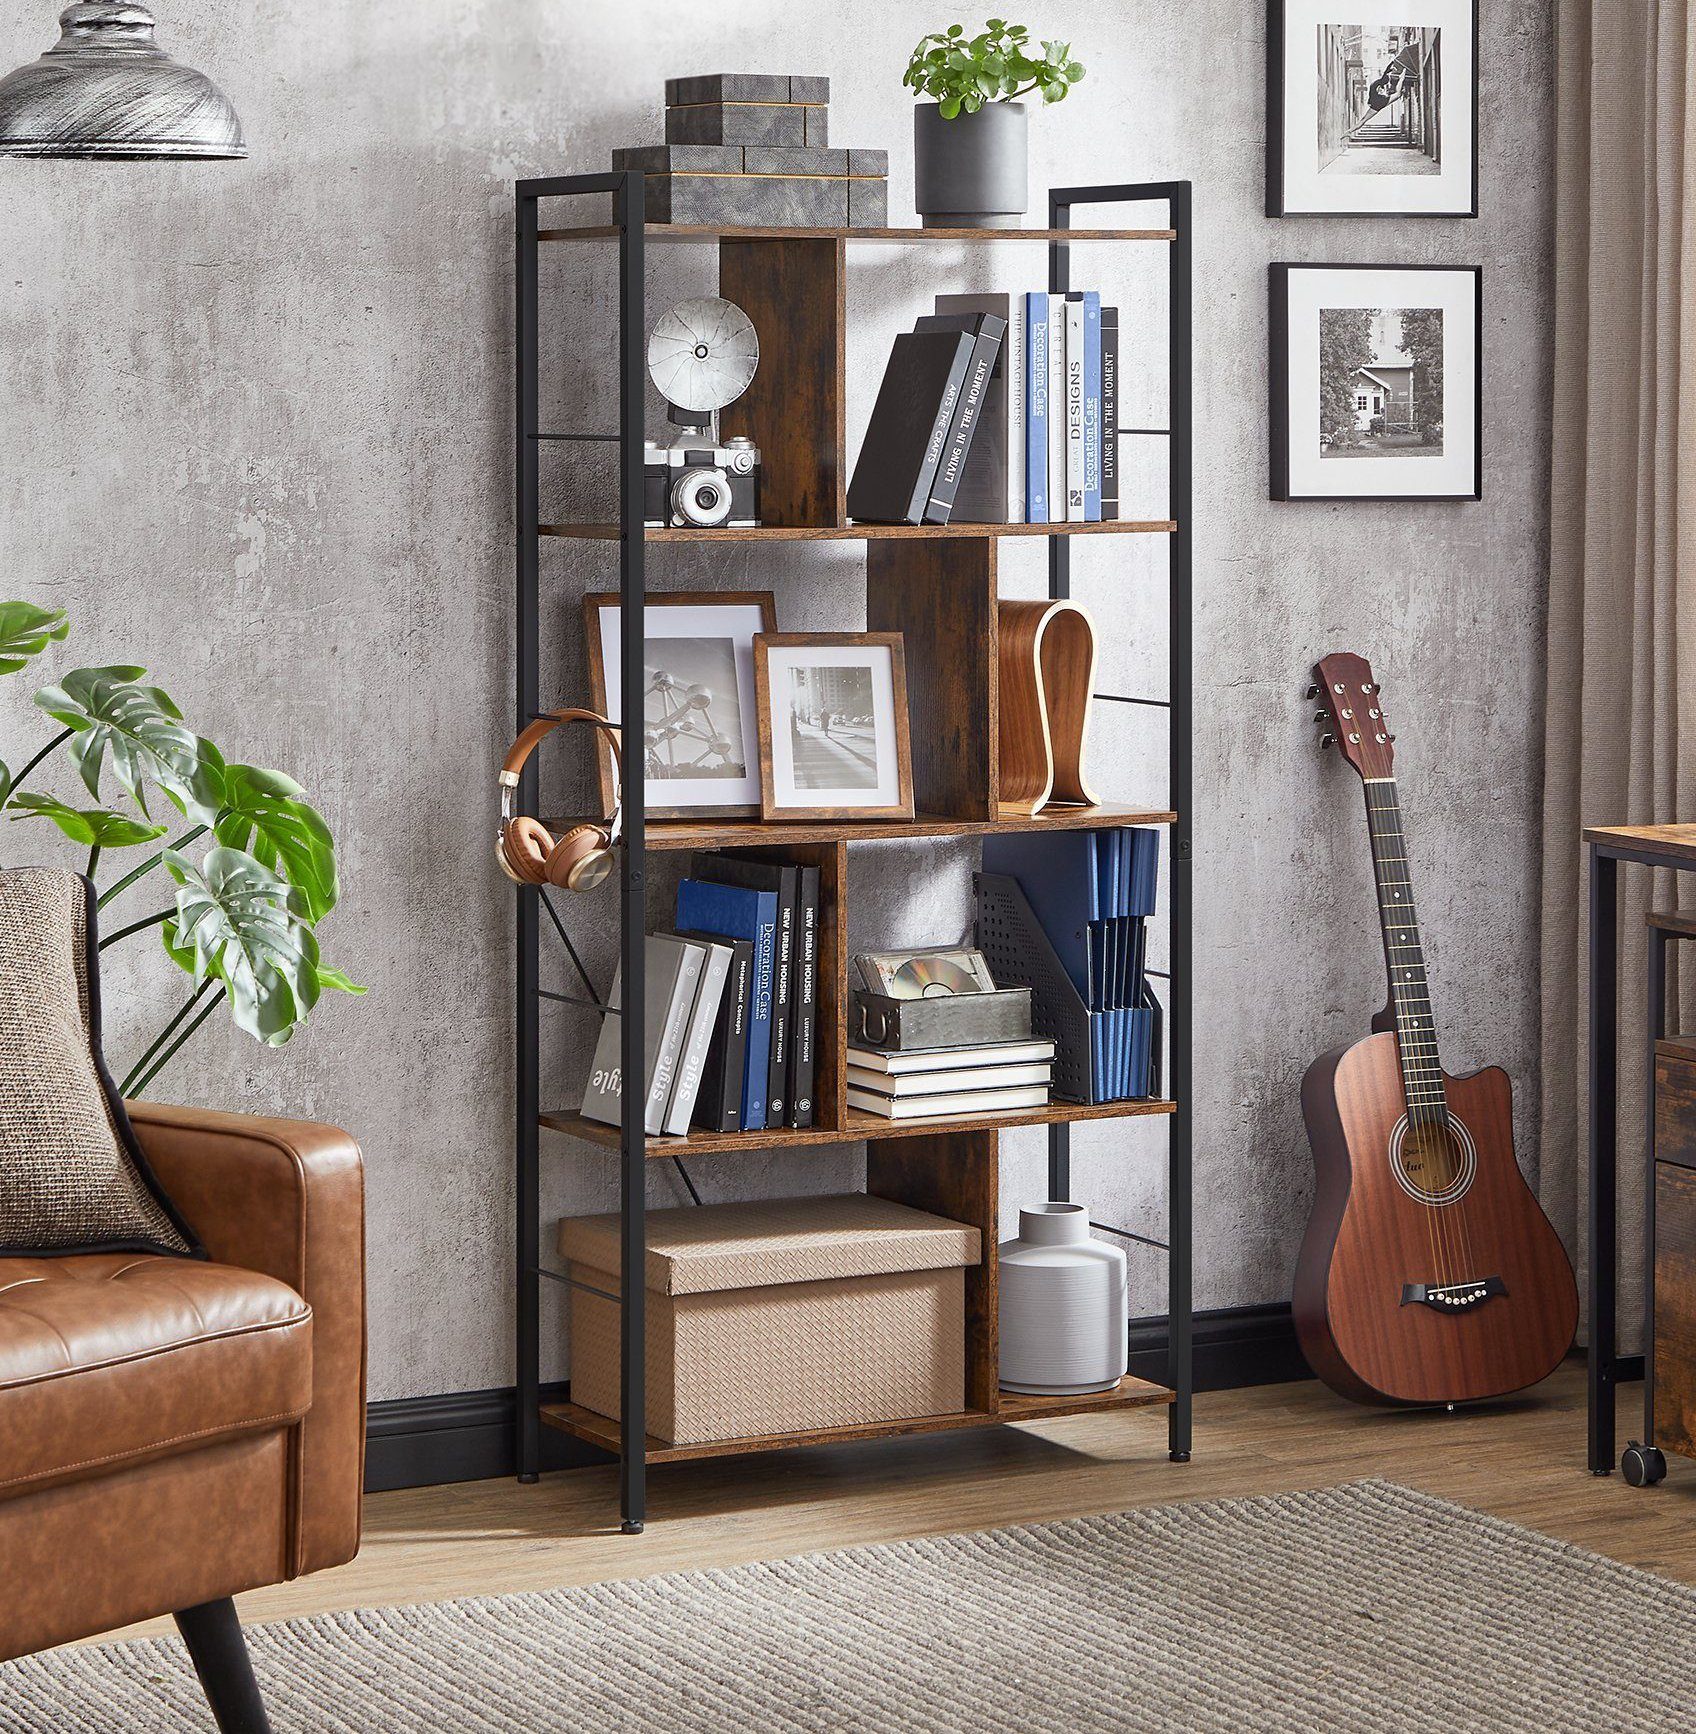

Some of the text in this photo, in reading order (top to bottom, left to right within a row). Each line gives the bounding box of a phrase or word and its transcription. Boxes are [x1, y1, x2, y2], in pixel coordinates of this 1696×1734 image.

[968, 359, 988, 405] MOMENT
[1037, 322, 1047, 417] Decoration Case
[928, 384, 957, 463] ARTS THE CRAFTS
[961, 408, 974, 429] THE
[1071, 361, 1081, 440] DESIGNS
[1105, 352, 1113, 478] LIVING IN THE MOMENT
[956, 432, 967, 445] IN
[1085, 398, 1094, 491] Decoration Case
[945, 447, 961, 483] LIVING
[738, 961, 746, 1003] Metaphorical
[760, 923, 774, 1020] Decoration Case
[780, 965, 788, 1004] HOUSING
[804, 964, 812, 1004] HOUSING
[594, 1068, 622, 1097] tyle
[653, 1055, 673, 1101] Style
[680, 1055, 699, 1101] Style
